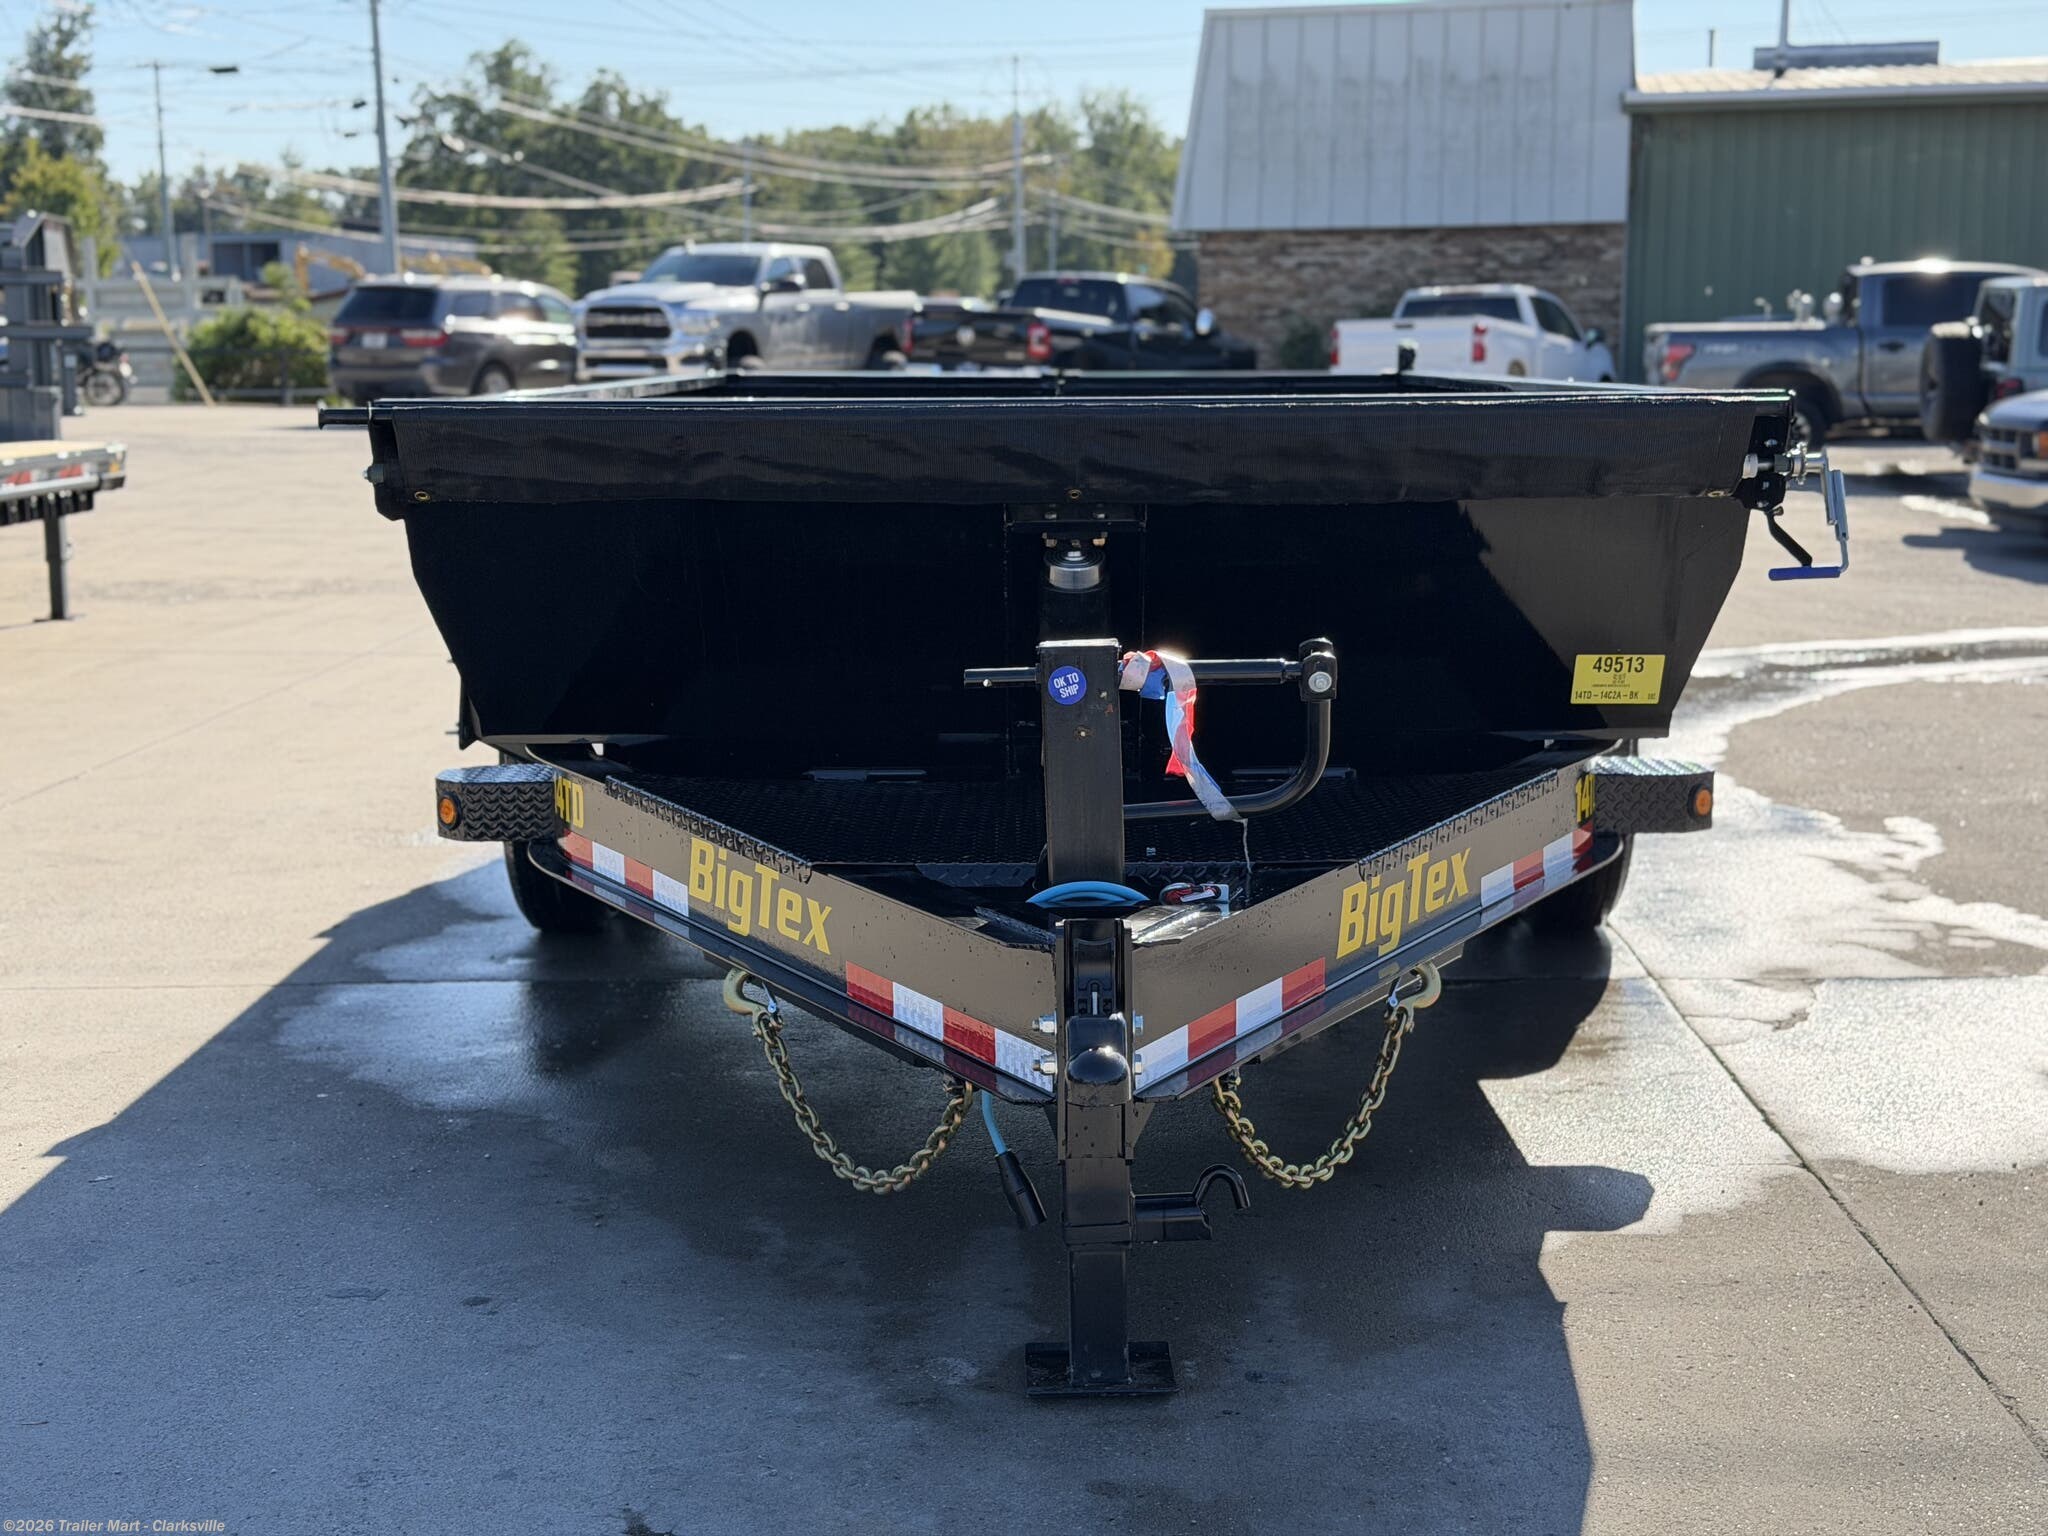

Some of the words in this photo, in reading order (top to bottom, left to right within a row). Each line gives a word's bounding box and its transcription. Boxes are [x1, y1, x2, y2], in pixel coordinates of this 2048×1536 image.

[1592, 656, 1645, 673] 49513
[1053, 676, 1067, 689] OK
[1066, 672, 1080, 684] TO
[1059, 684, 1079, 698] SHIP
[688, 837, 832, 955] BigTex
[1337, 848, 1471, 959] BigTex
